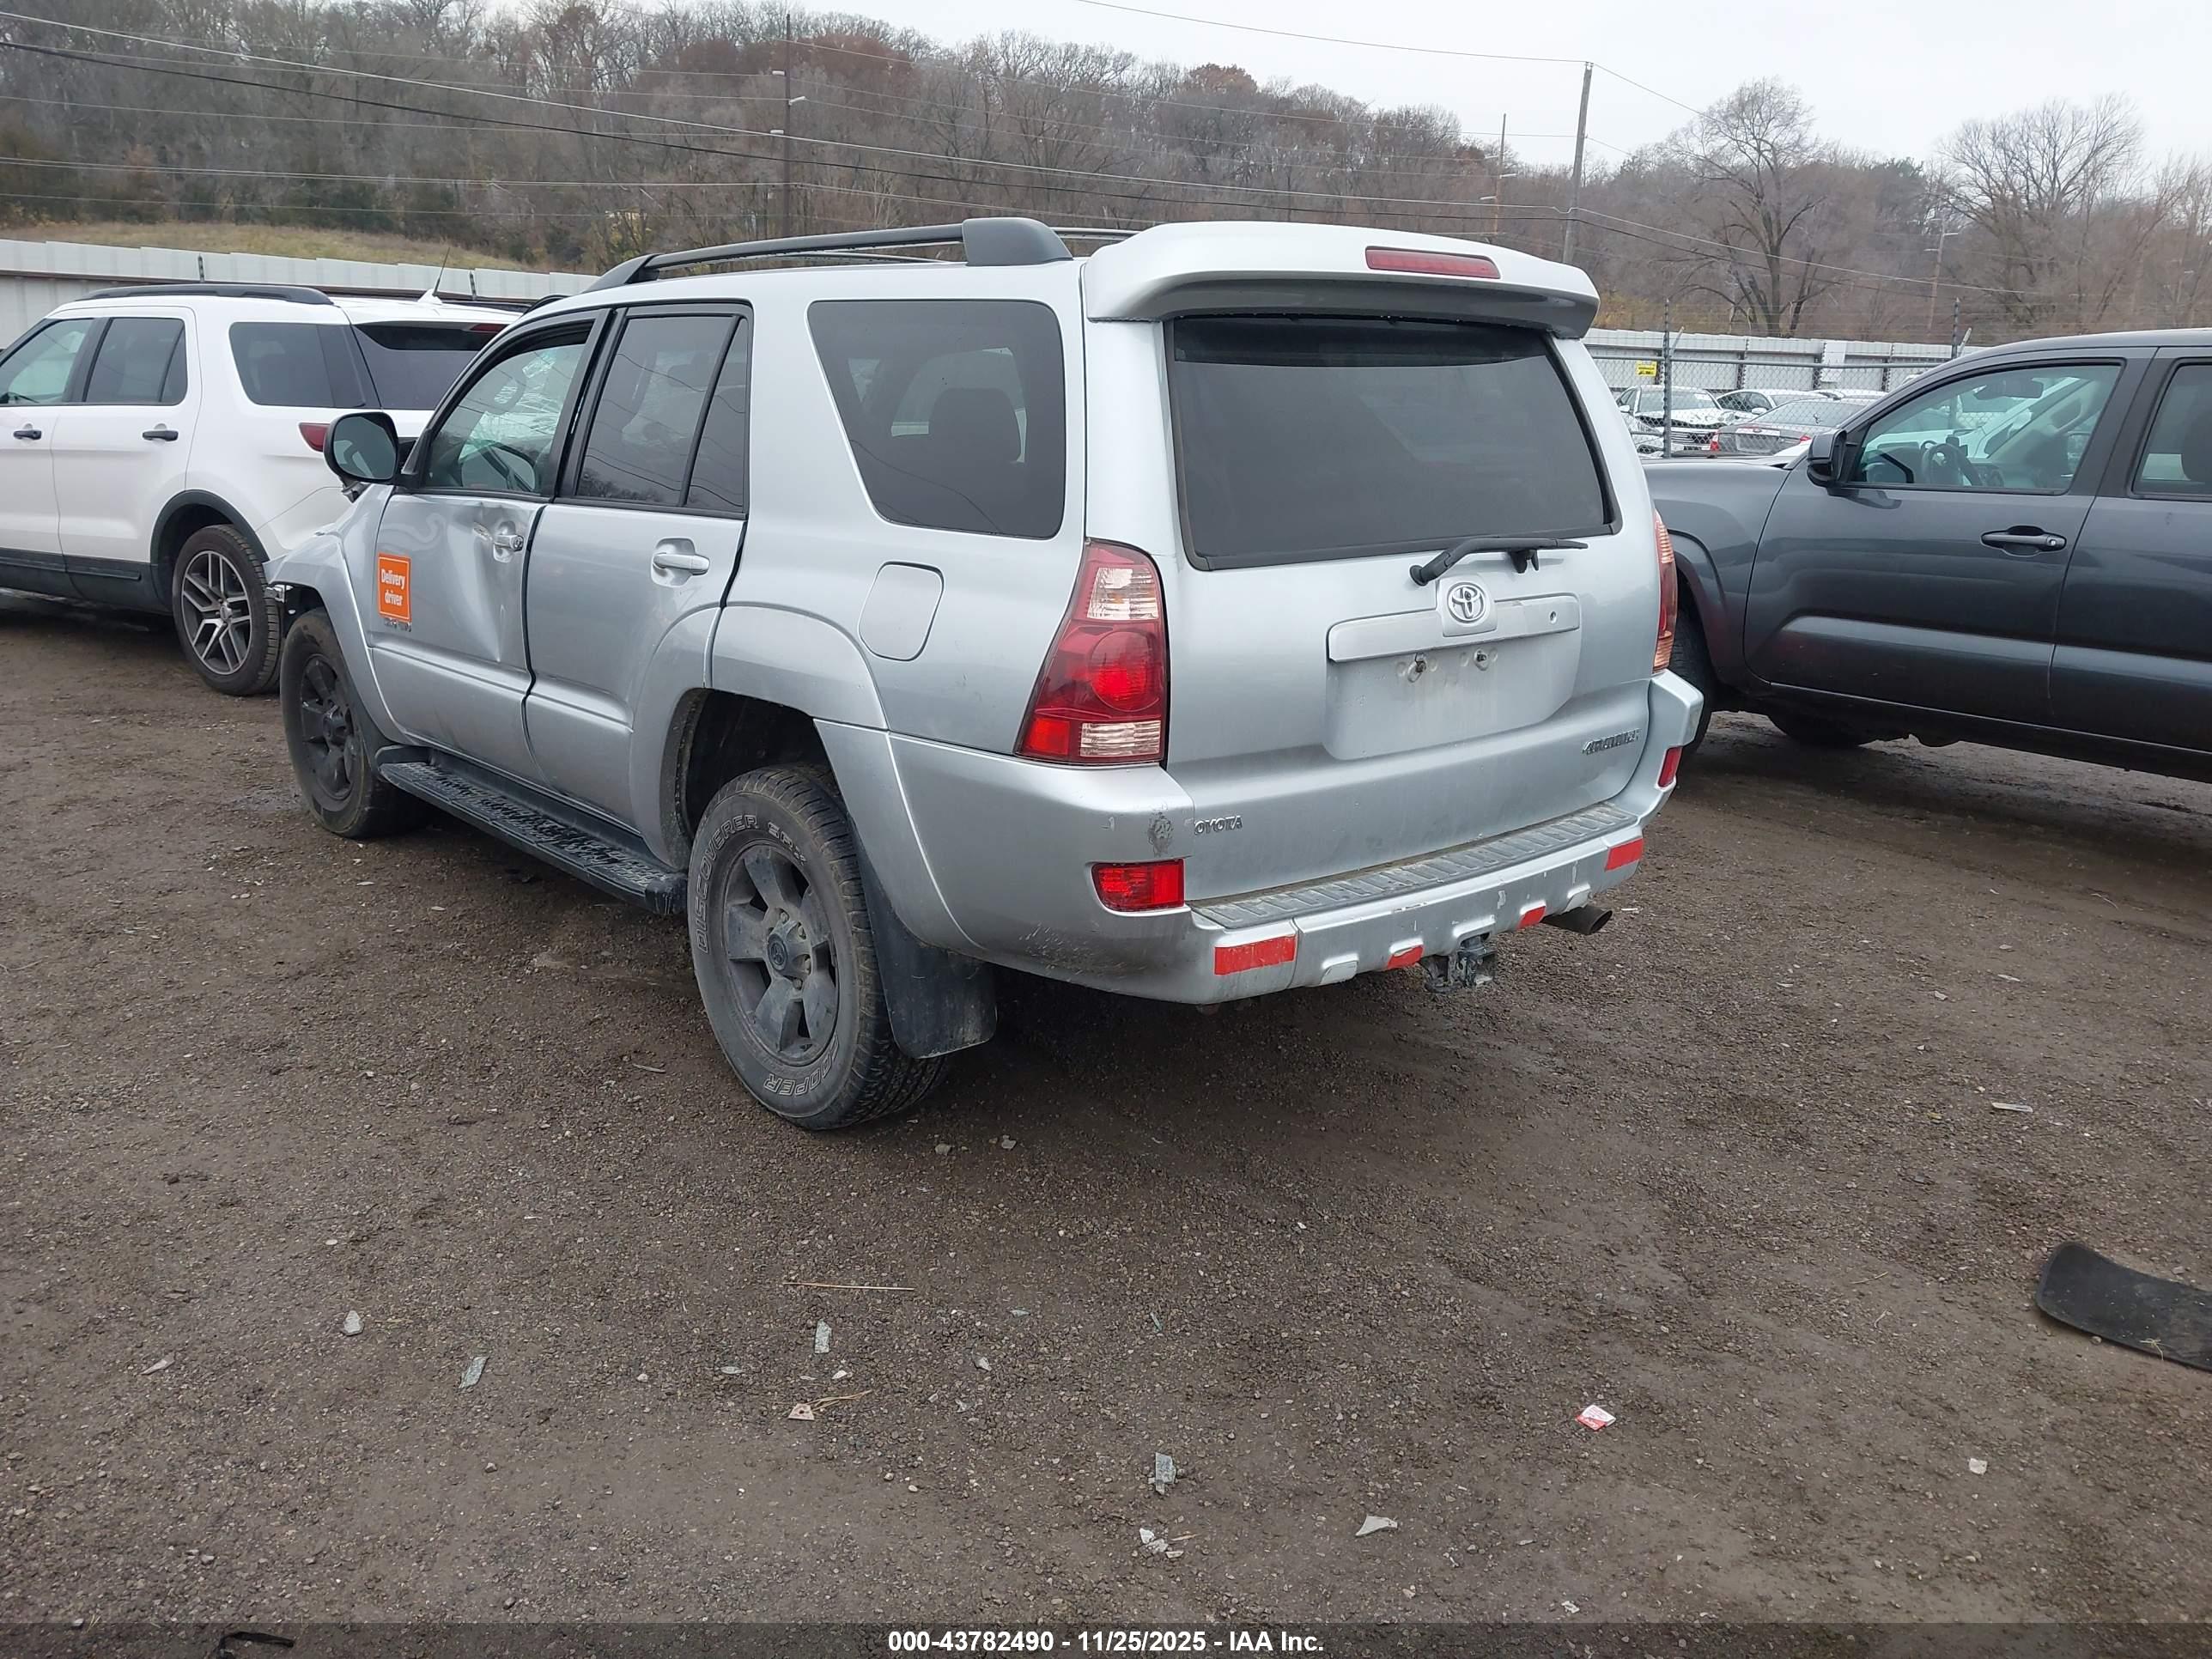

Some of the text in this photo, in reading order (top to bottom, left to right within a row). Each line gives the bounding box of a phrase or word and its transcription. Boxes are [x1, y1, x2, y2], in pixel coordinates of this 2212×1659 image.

[380, 568, 406, 591] Delivery
[384, 589, 404, 607] driver
[1194, 814, 1243, 836] OYOTA
[695, 814, 759, 954] DISCOVERER
[763, 1031, 840, 1096] COOPER
